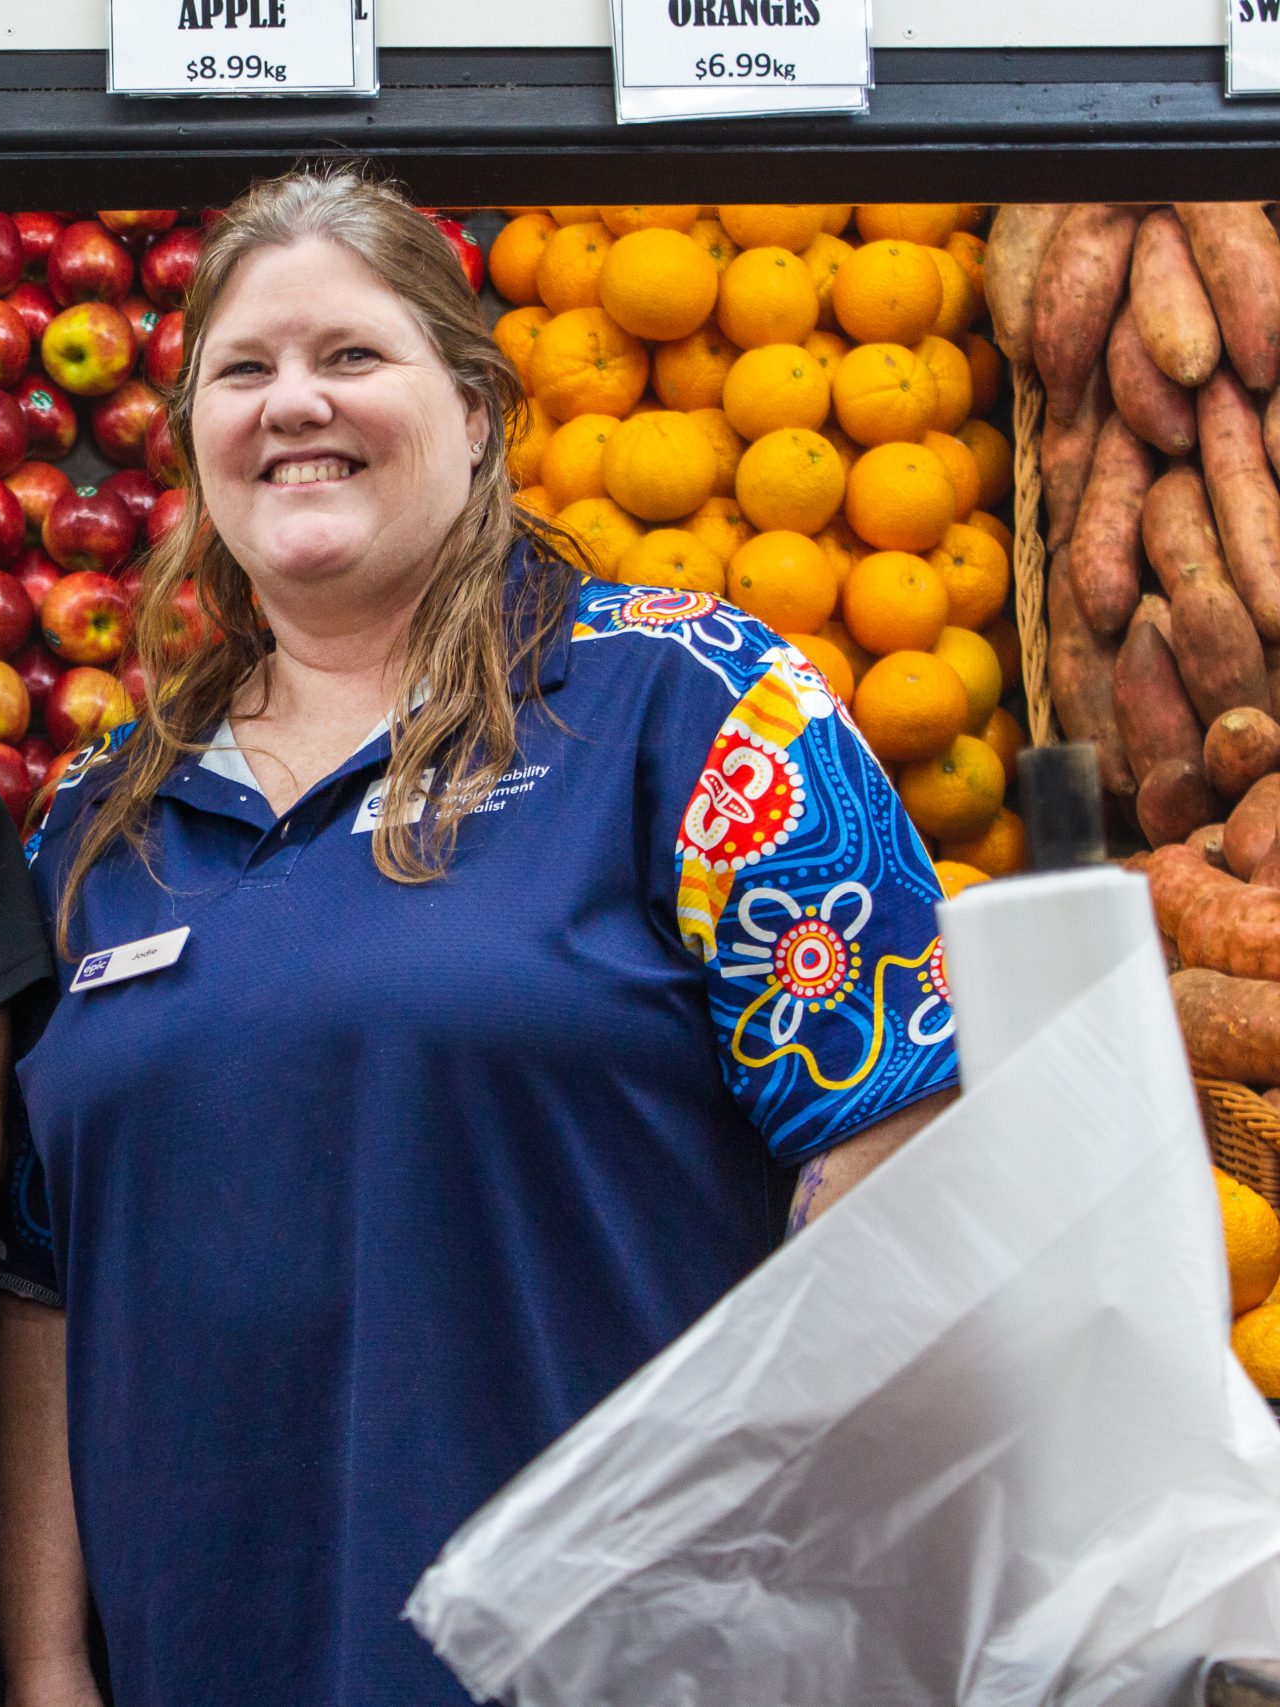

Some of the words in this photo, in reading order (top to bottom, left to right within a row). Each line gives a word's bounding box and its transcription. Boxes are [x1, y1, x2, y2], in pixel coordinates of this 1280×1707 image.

[178, 0, 286, 30] APPLE
[668, 0, 820, 27] ORANGES
[186, 55, 287, 82] $8.99kg
[695, 53, 796, 81] $6.99kg
[83, 960, 106, 975] epic
